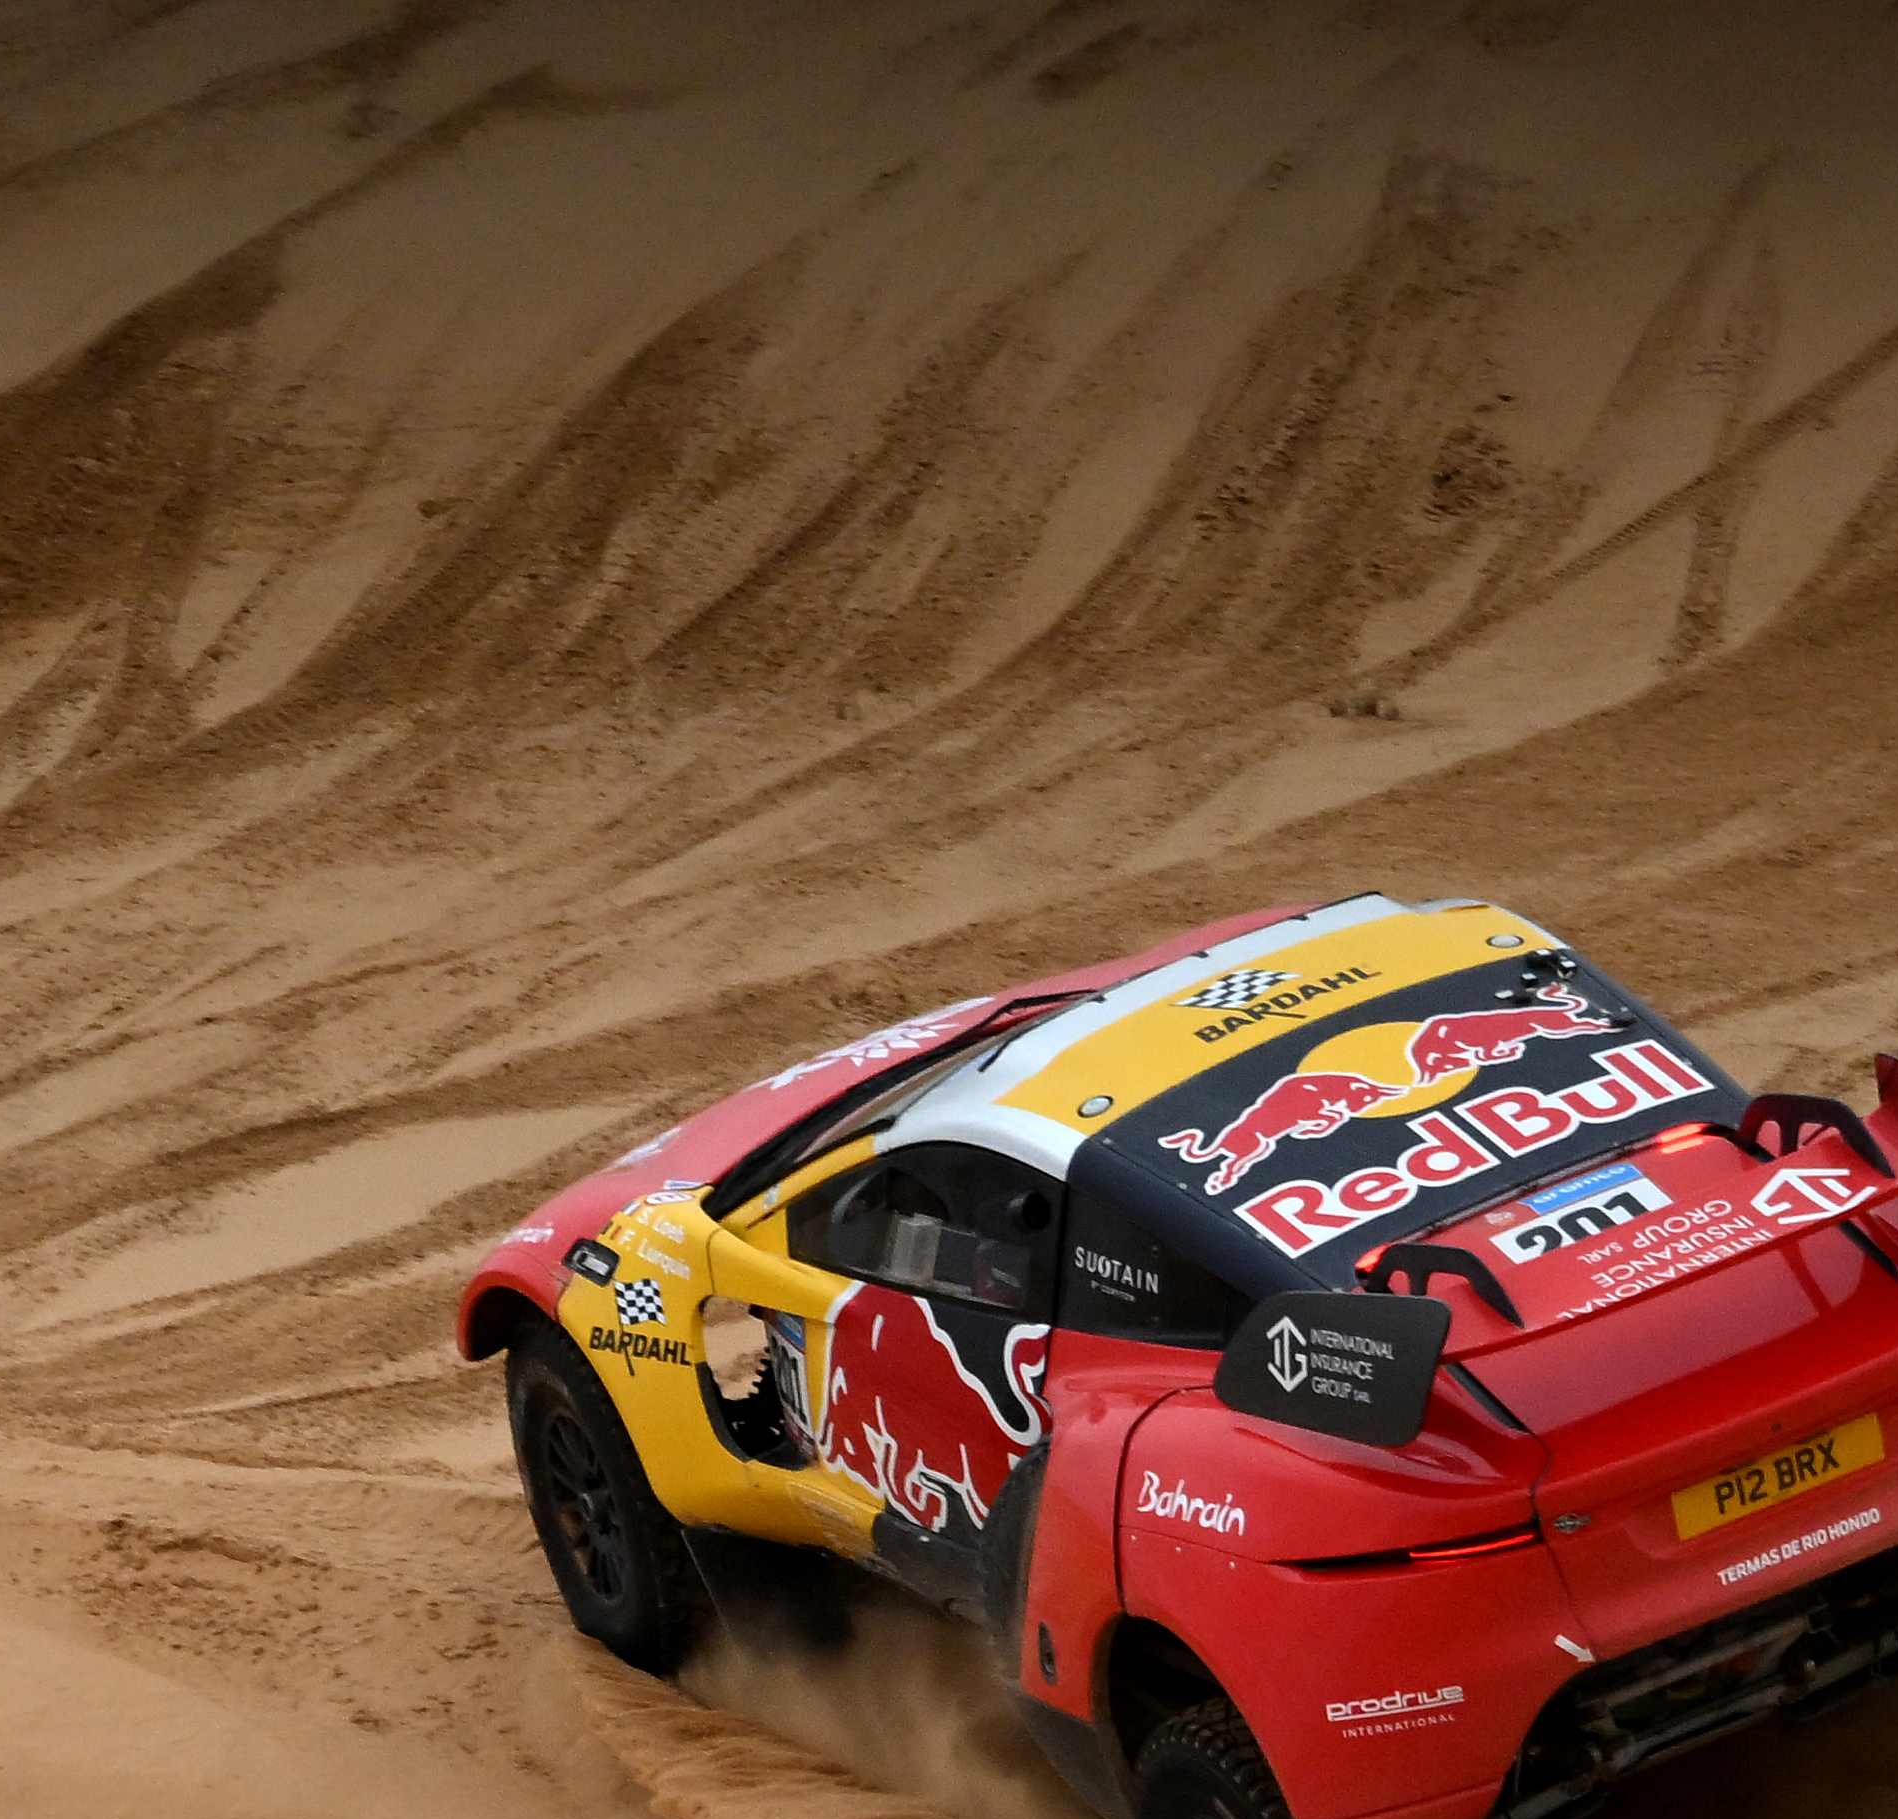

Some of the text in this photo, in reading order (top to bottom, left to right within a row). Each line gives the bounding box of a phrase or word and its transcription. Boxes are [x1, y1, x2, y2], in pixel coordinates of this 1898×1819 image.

[1194, 967, 1382, 1043] BARDAHL
[1234, 1040, 1716, 1258] Red Bull
[1577, 1199, 1733, 1265] GROUP SARL
[1591, 1215, 1755, 1289] INSURANCE
[1556, 1229, 1774, 1320] INTERNATIONAL
[589, 1326, 692, 1367] BARDAHL
[1311, 1376, 1352, 1399] GROUP
[1137, 1470, 1247, 1536] Bahrain
[1714, 1438, 1840, 1515] P12 BRX
[1717, 1507, 1881, 1585] TERMAS DE RIO HONDO
[1326, 1684, 1465, 1722] prodrive
[1342, 1714, 1457, 1739] INTERNATIONAL
